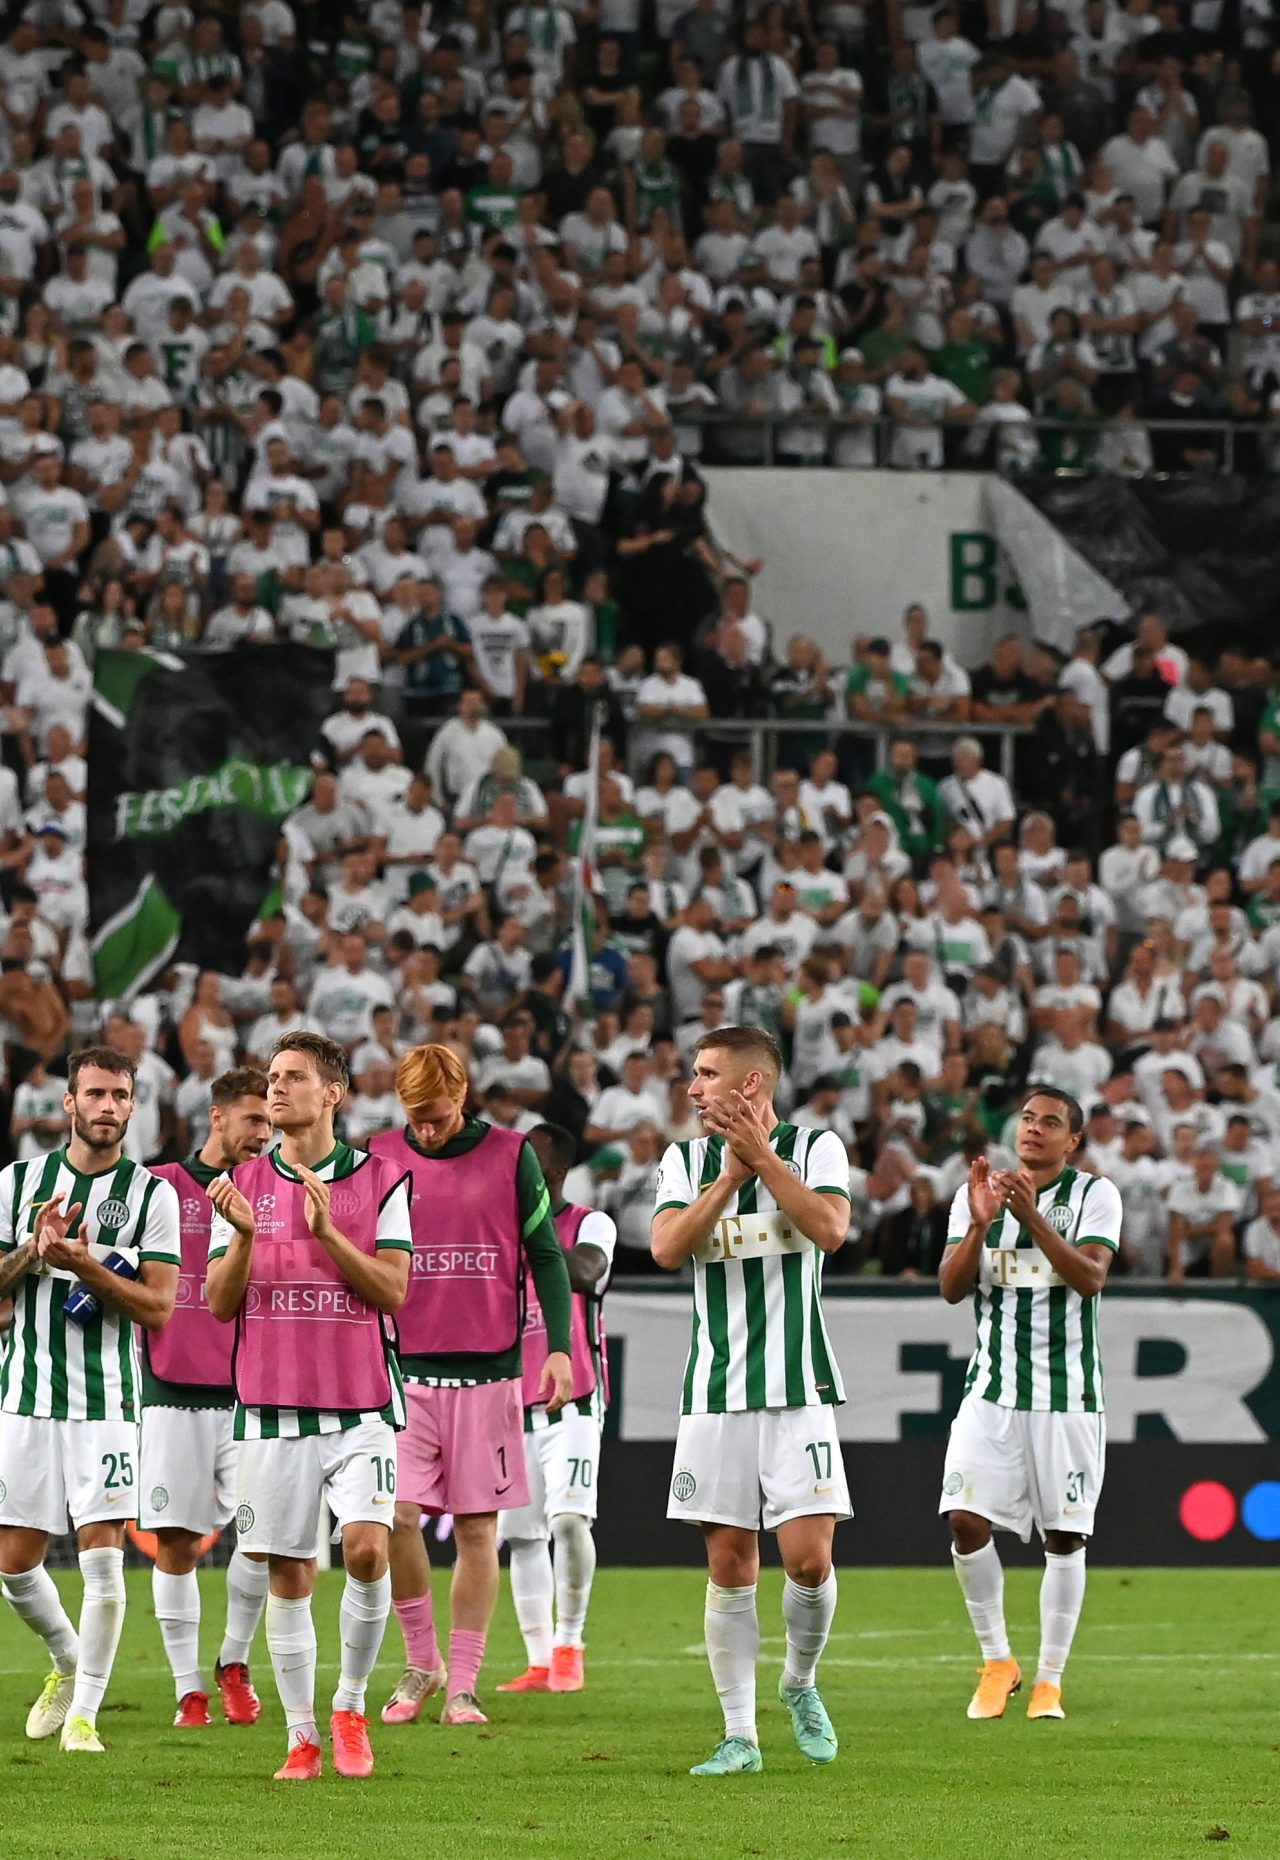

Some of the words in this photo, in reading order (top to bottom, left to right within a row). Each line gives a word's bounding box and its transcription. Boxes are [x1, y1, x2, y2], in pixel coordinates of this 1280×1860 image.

[255, 1227, 278, 1235] EAGUE
[412, 1251, 499, 1272] RESPECT
[101, 1451, 134, 1489] 25
[370, 1455, 396, 1495] 16
[496, 1446, 507, 1479] 1
[567, 1458, 592, 1488] 70
[805, 1441, 832, 1480] 17
[1066, 1470, 1086, 1504] 31
